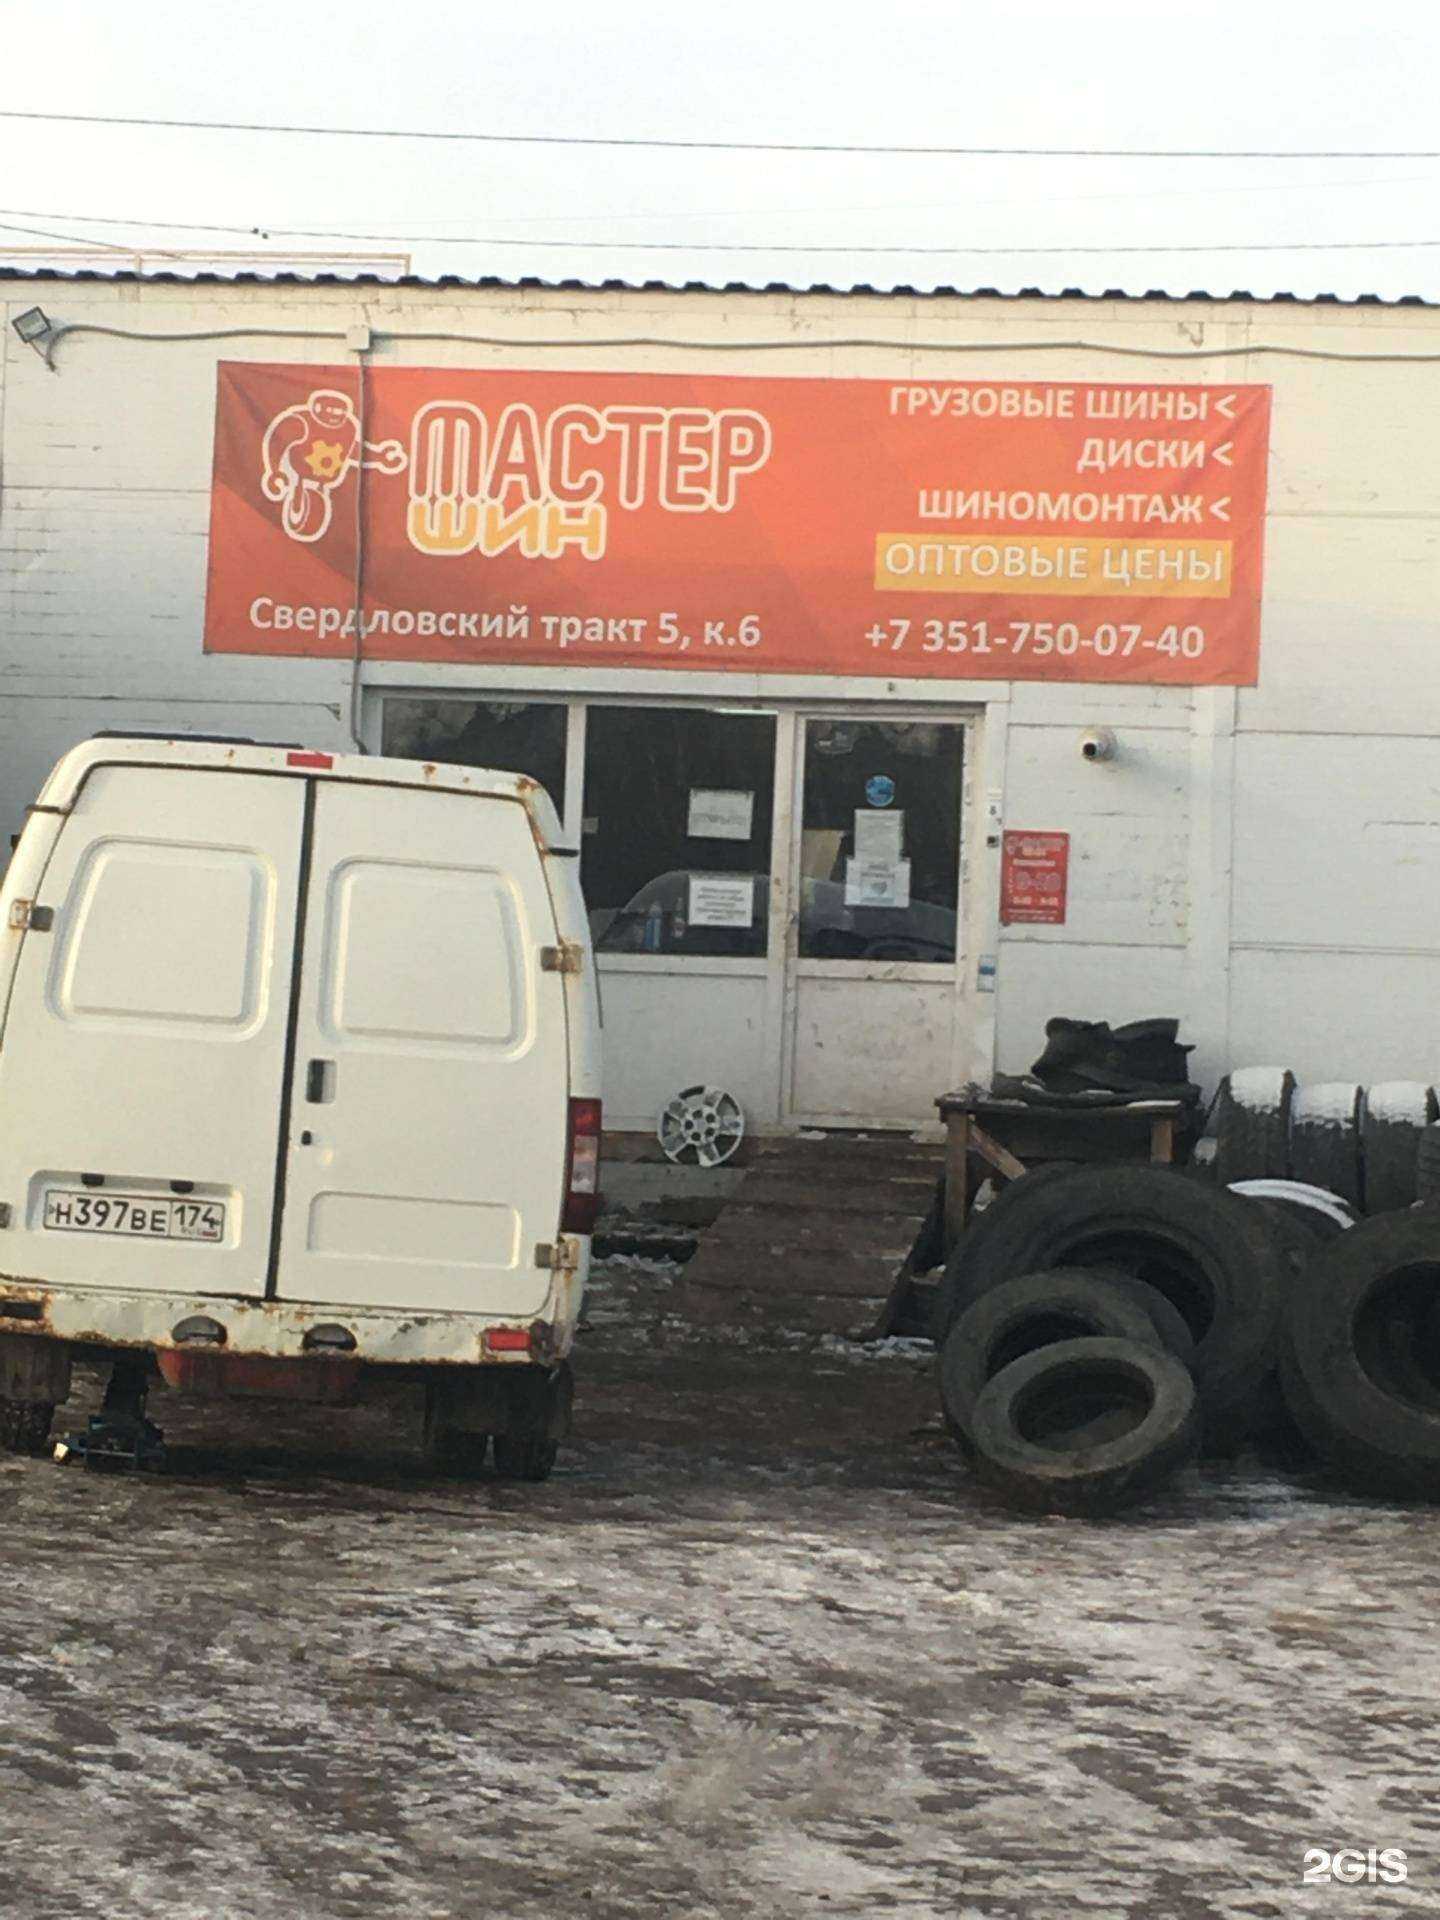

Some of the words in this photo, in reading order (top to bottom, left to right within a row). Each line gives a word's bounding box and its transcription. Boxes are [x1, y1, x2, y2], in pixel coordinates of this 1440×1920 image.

[889, 386, 1074, 418] ГРУЗОВЫЕ
[1085, 392, 1208, 420] ШИНЫ
[409, 400, 771, 512] МАСТЕР
[1076, 438, 1205, 474] ДИСКИ
[918, 490, 1203, 524] ШИНОМОНТАЖ
[407, 500, 607, 560] ШИН
[884, 542, 1087, 580] ОПТОВЫЕ
[1102, 548, 1223, 587] ЦЕНЫ
[249, 597, 529, 640] Свердловский
[541, 614, 647, 645] тракт
[657, 612, 693, 652] 5,
[703, 616, 762, 647] к.6
[864, 619, 910, 651] +7
[923, 620, 1205, 658] 351-750-07-40
[174, 1204, 220, 1229] 174
